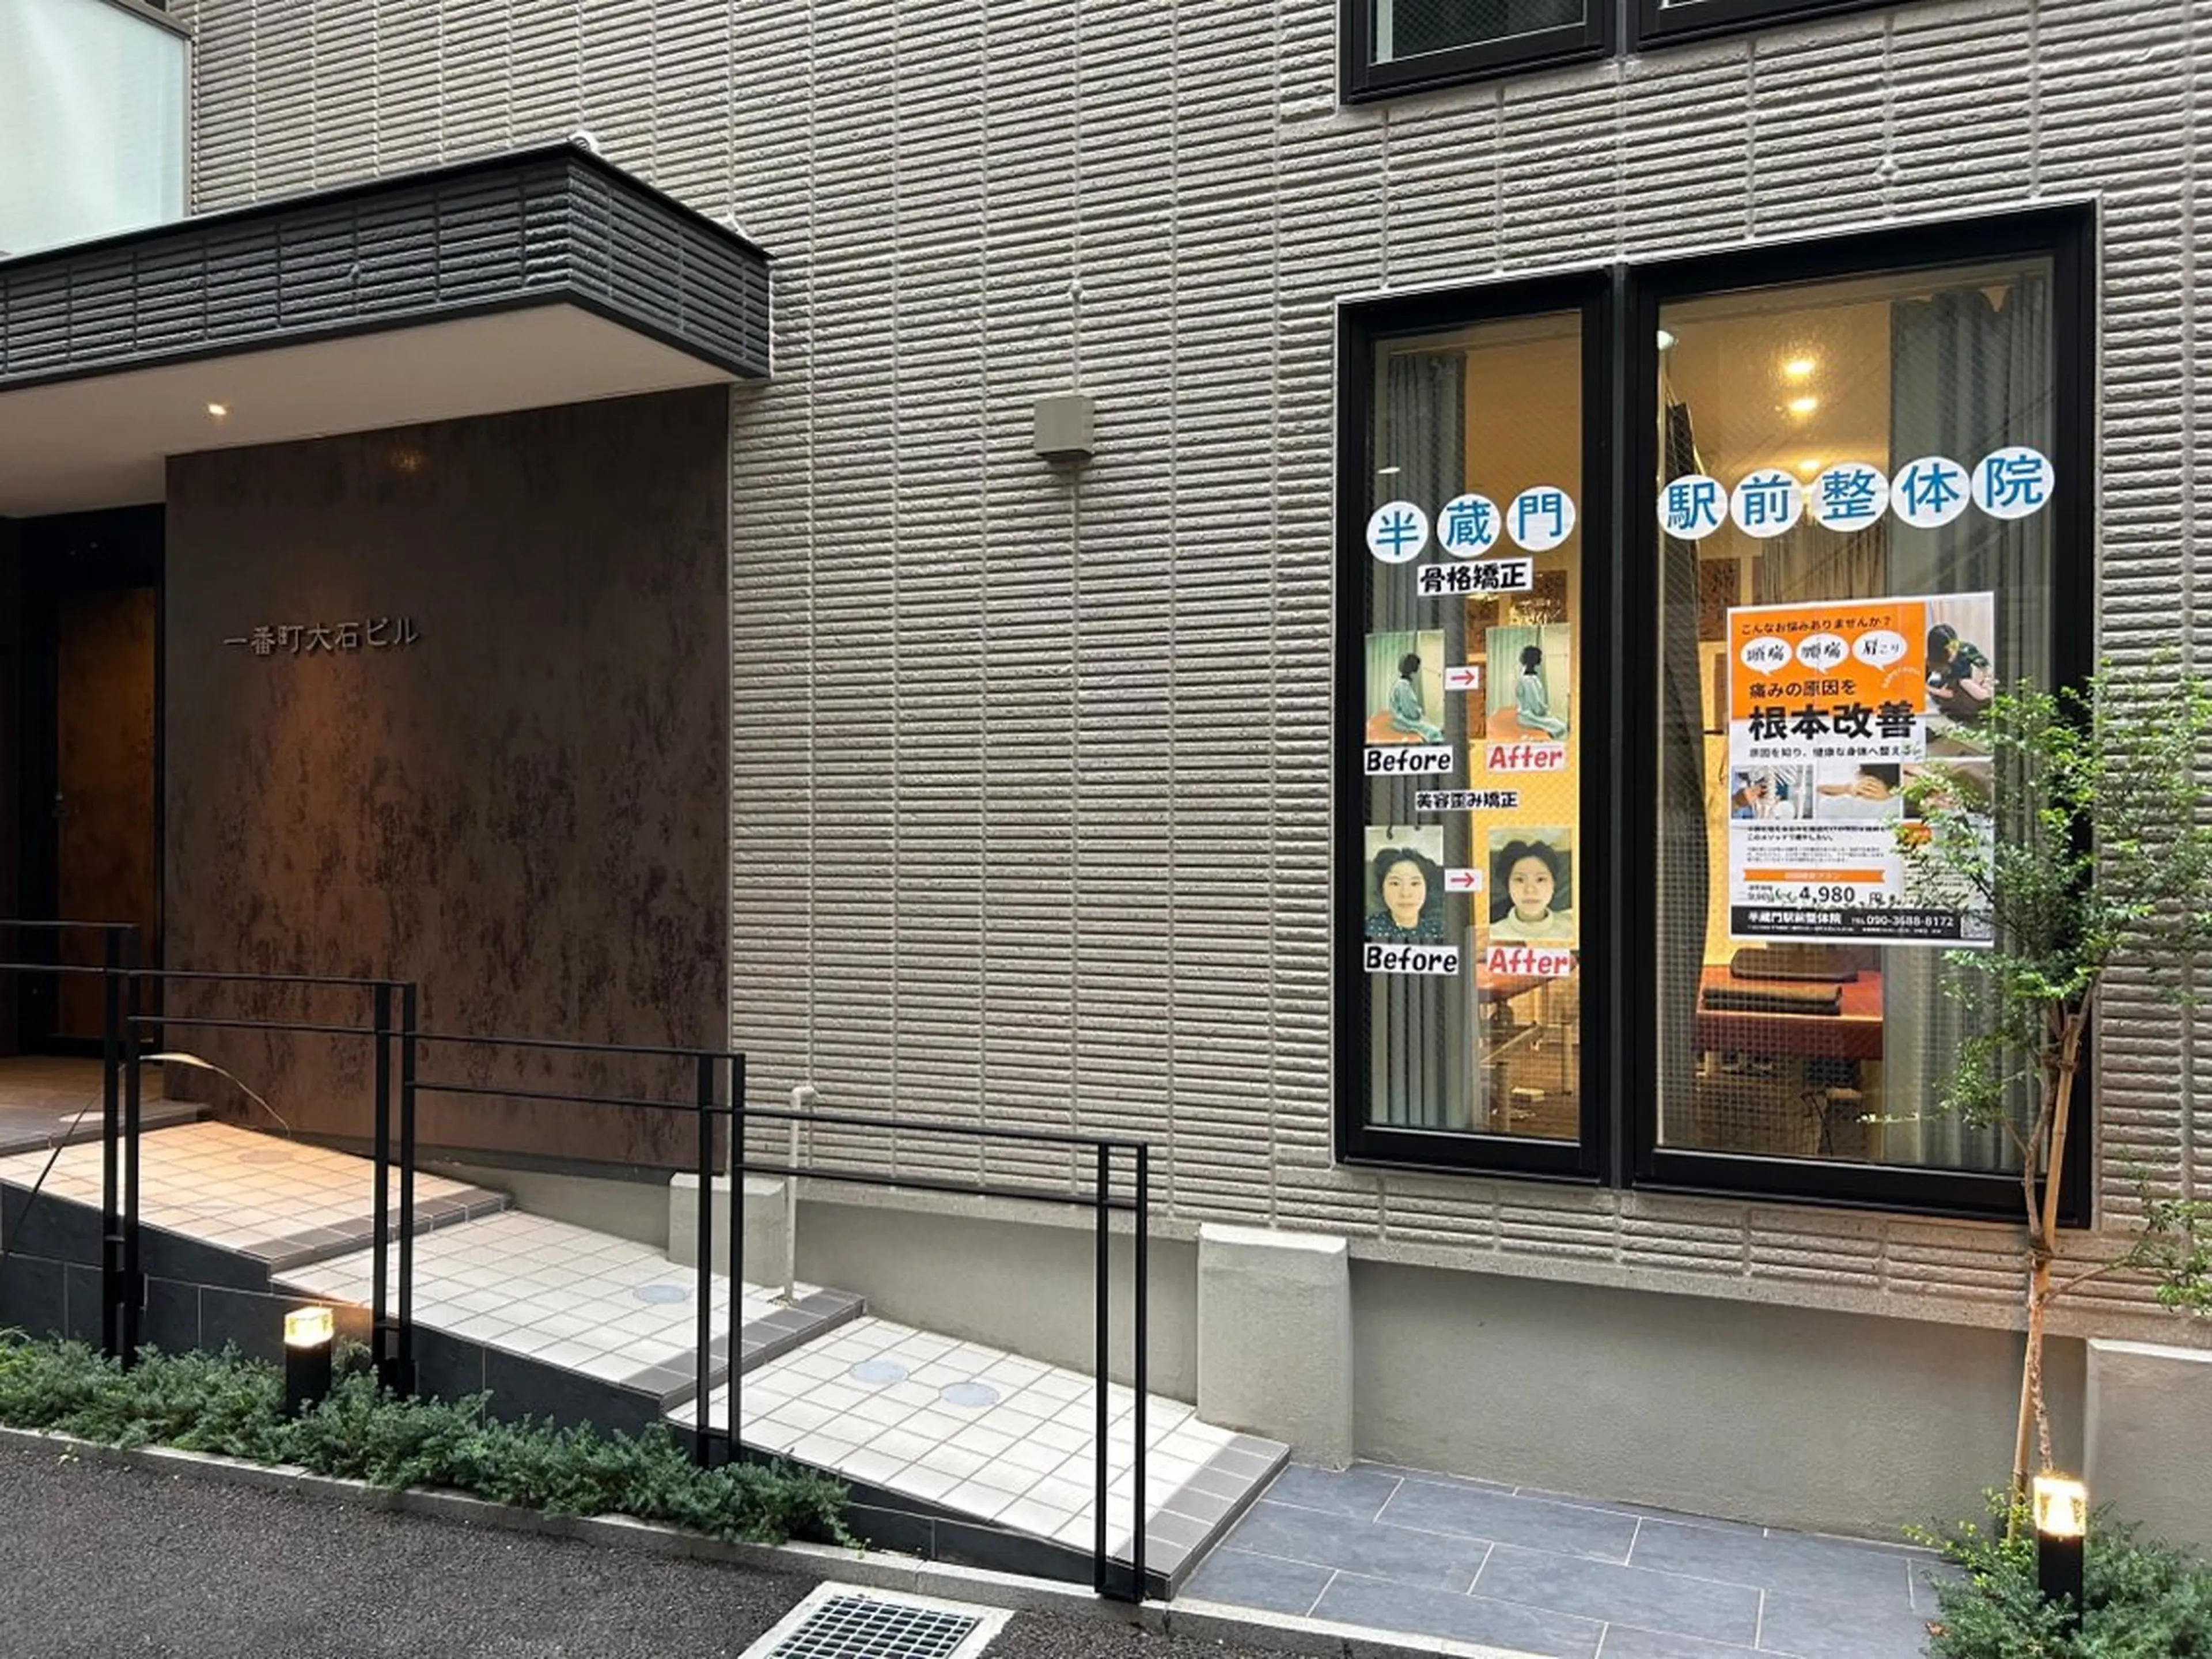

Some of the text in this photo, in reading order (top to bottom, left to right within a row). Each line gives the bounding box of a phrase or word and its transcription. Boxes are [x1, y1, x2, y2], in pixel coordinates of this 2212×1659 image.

[1375, 453, 2044, 556] 半蔵門 駅前整体院
[1420, 562, 1528, 593] 骨格矯正
[223, 617, 419, 656] 一番町大石ビル
[1863, 638, 1900, 656] 肩こり
[1749, 679, 1857, 699] 痛みの原因を
[1748, 700, 1916, 741] 根本改善
[1366, 749, 1451, 772] Before
[1488, 745, 1563, 768] After
[1416, 791, 1518, 809] 美容歪み矯正
[1798, 885, 1855, 904] 4,980
[1866, 914, 1955, 927] 090-3688-8172
[1366, 945, 1458, 972] Before
[1488, 948, 1569, 974] After
